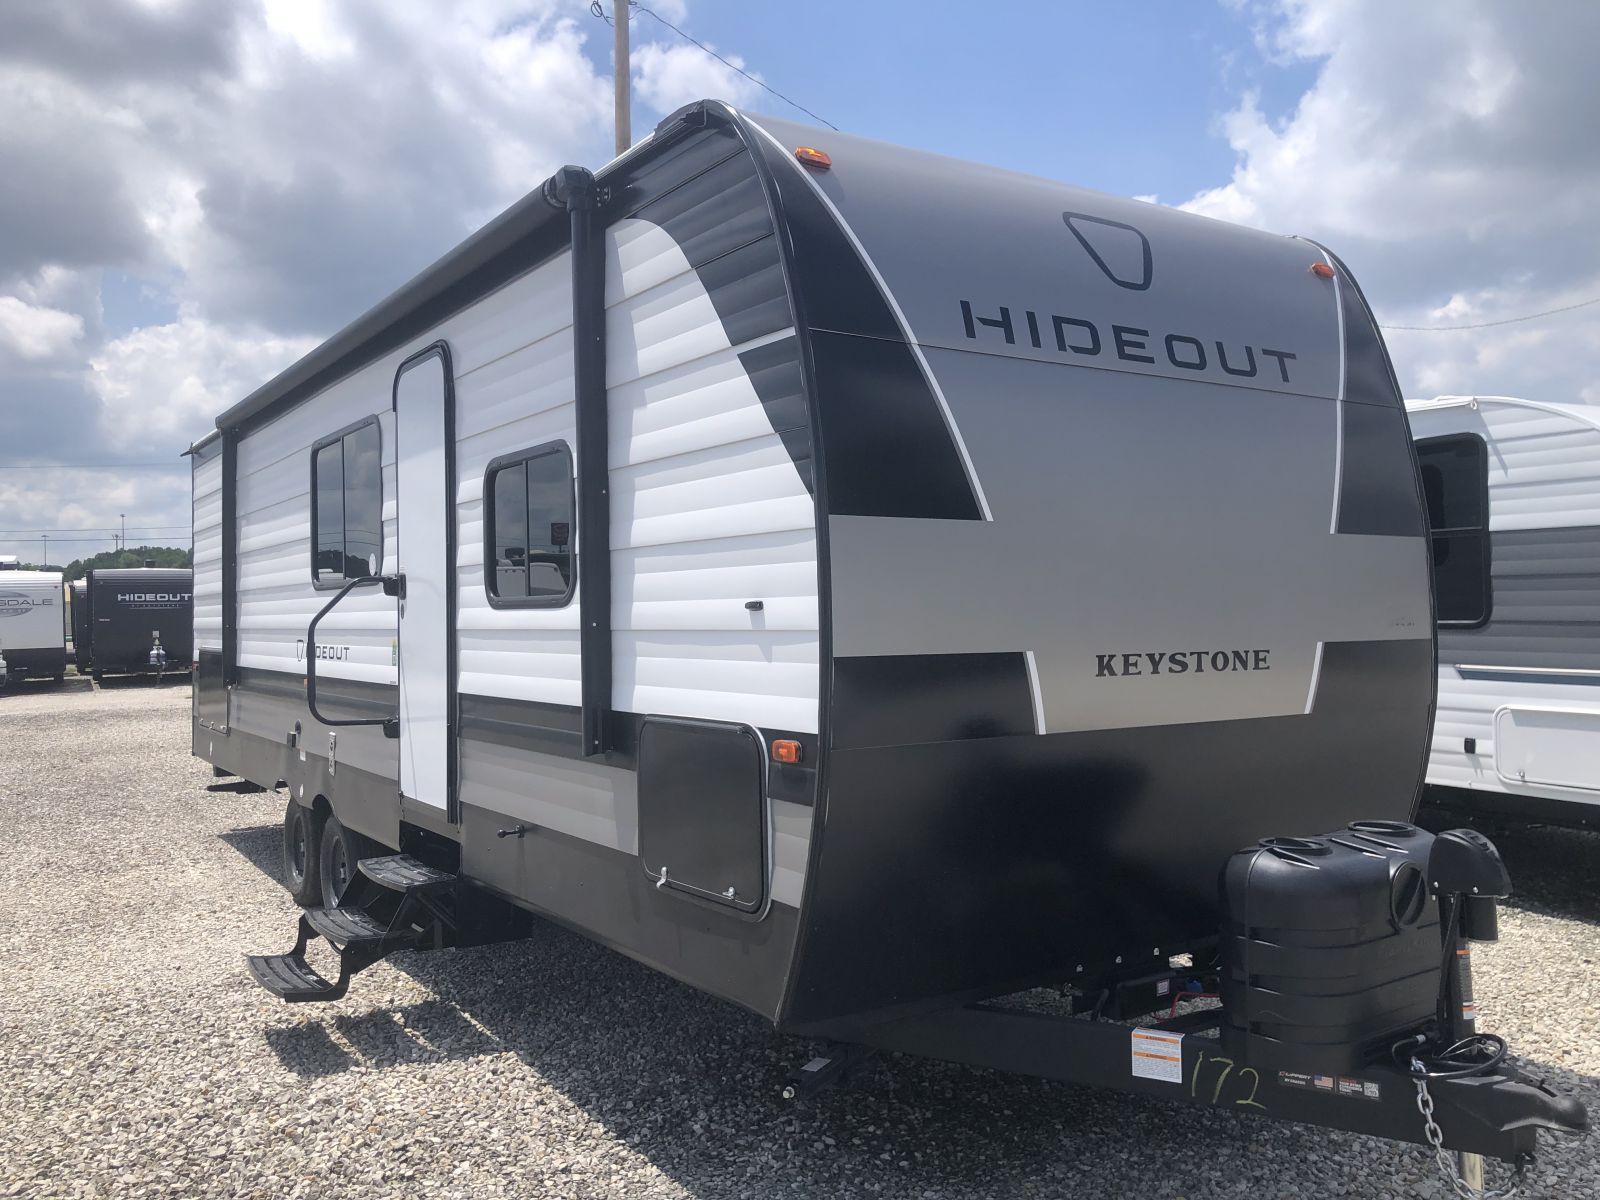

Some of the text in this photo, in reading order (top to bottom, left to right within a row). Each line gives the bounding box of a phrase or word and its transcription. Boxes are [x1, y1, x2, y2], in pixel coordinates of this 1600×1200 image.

[960, 300, 1297, 383] HIDEOUT
[117, 593, 192, 601] HIDEOUT
[306, 645, 350, 661] DEOUT
[1096, 649, 1271, 677] KEYSTONE
[1191, 1051, 1267, 1110] 172
